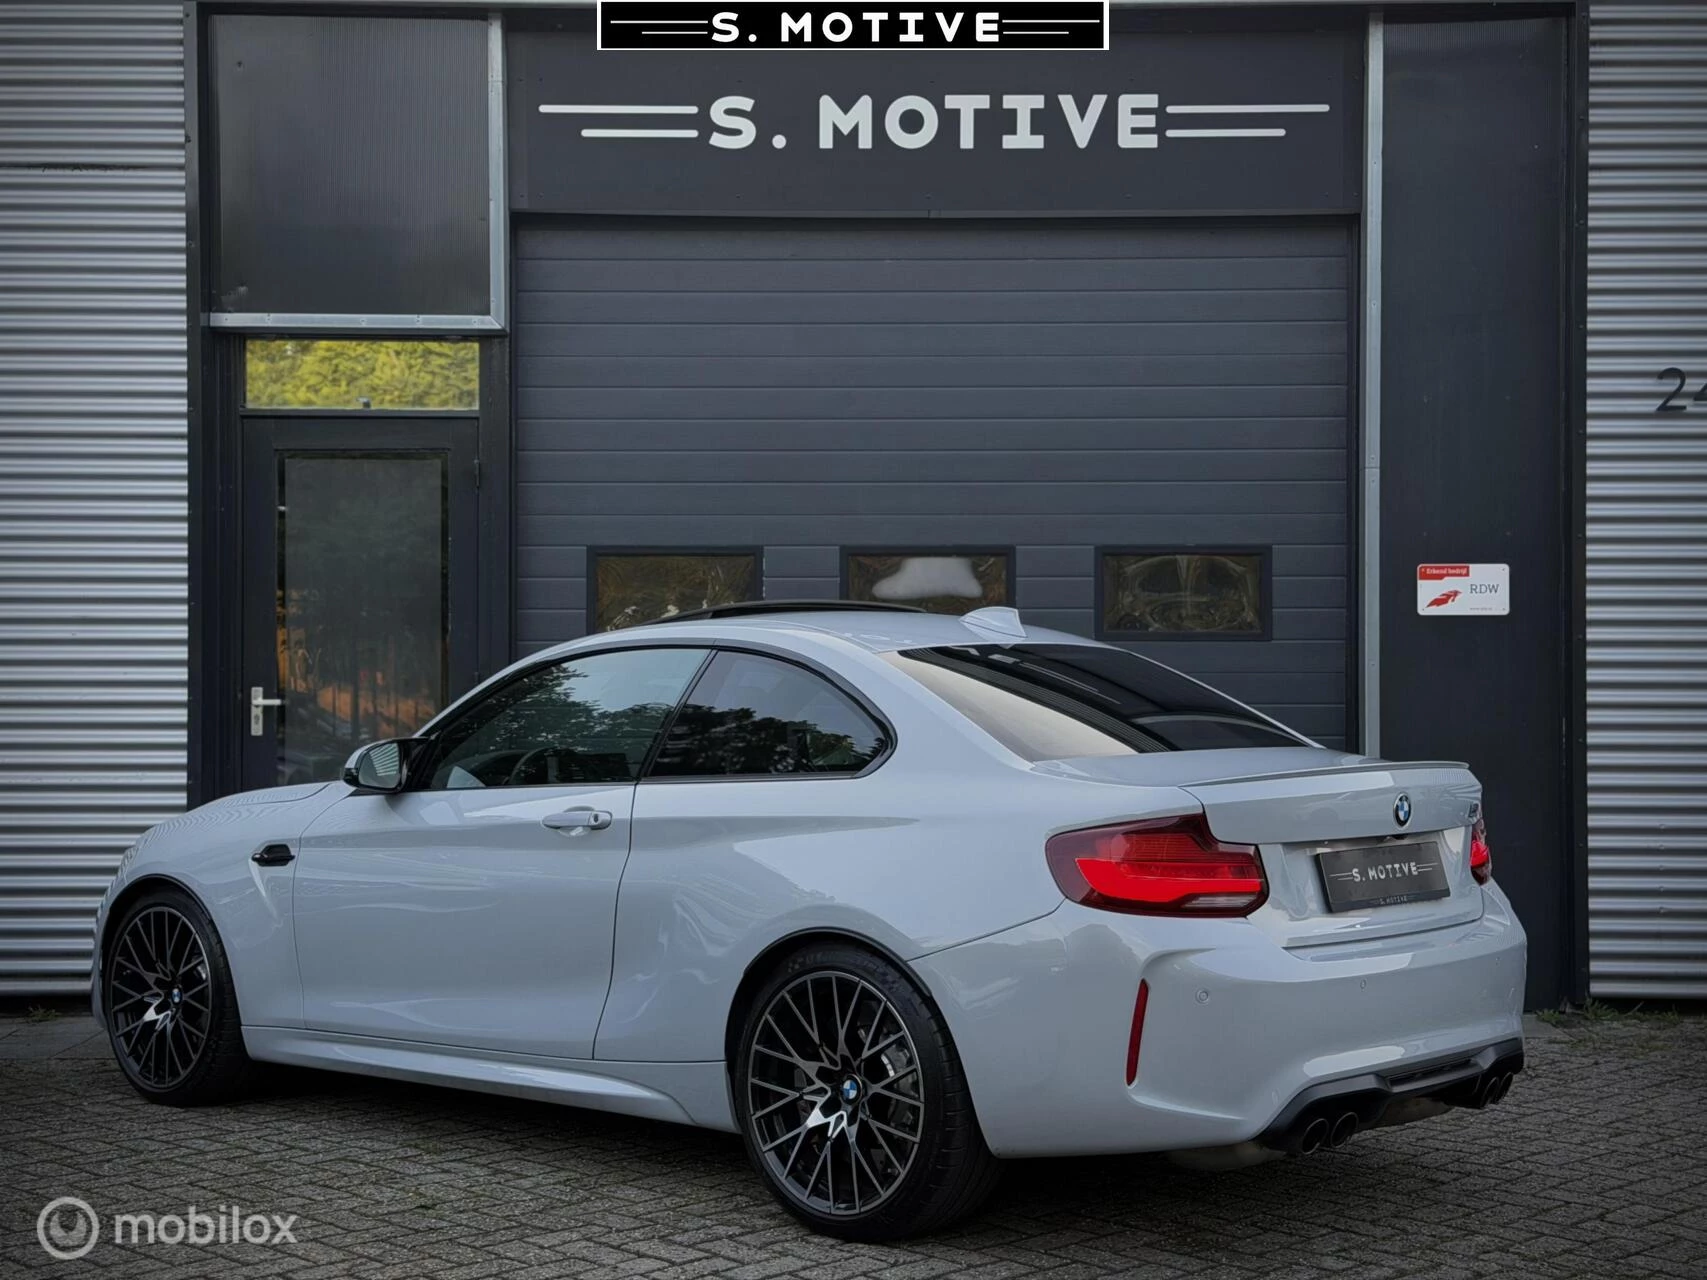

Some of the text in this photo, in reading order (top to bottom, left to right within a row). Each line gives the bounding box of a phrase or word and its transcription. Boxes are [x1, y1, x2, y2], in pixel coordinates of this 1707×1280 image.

[708, 93, 1159, 150] S. MOTIVE
[1470, 583, 1500, 594] RDW
[1352, 862, 1418, 882] S. MOTIVE
